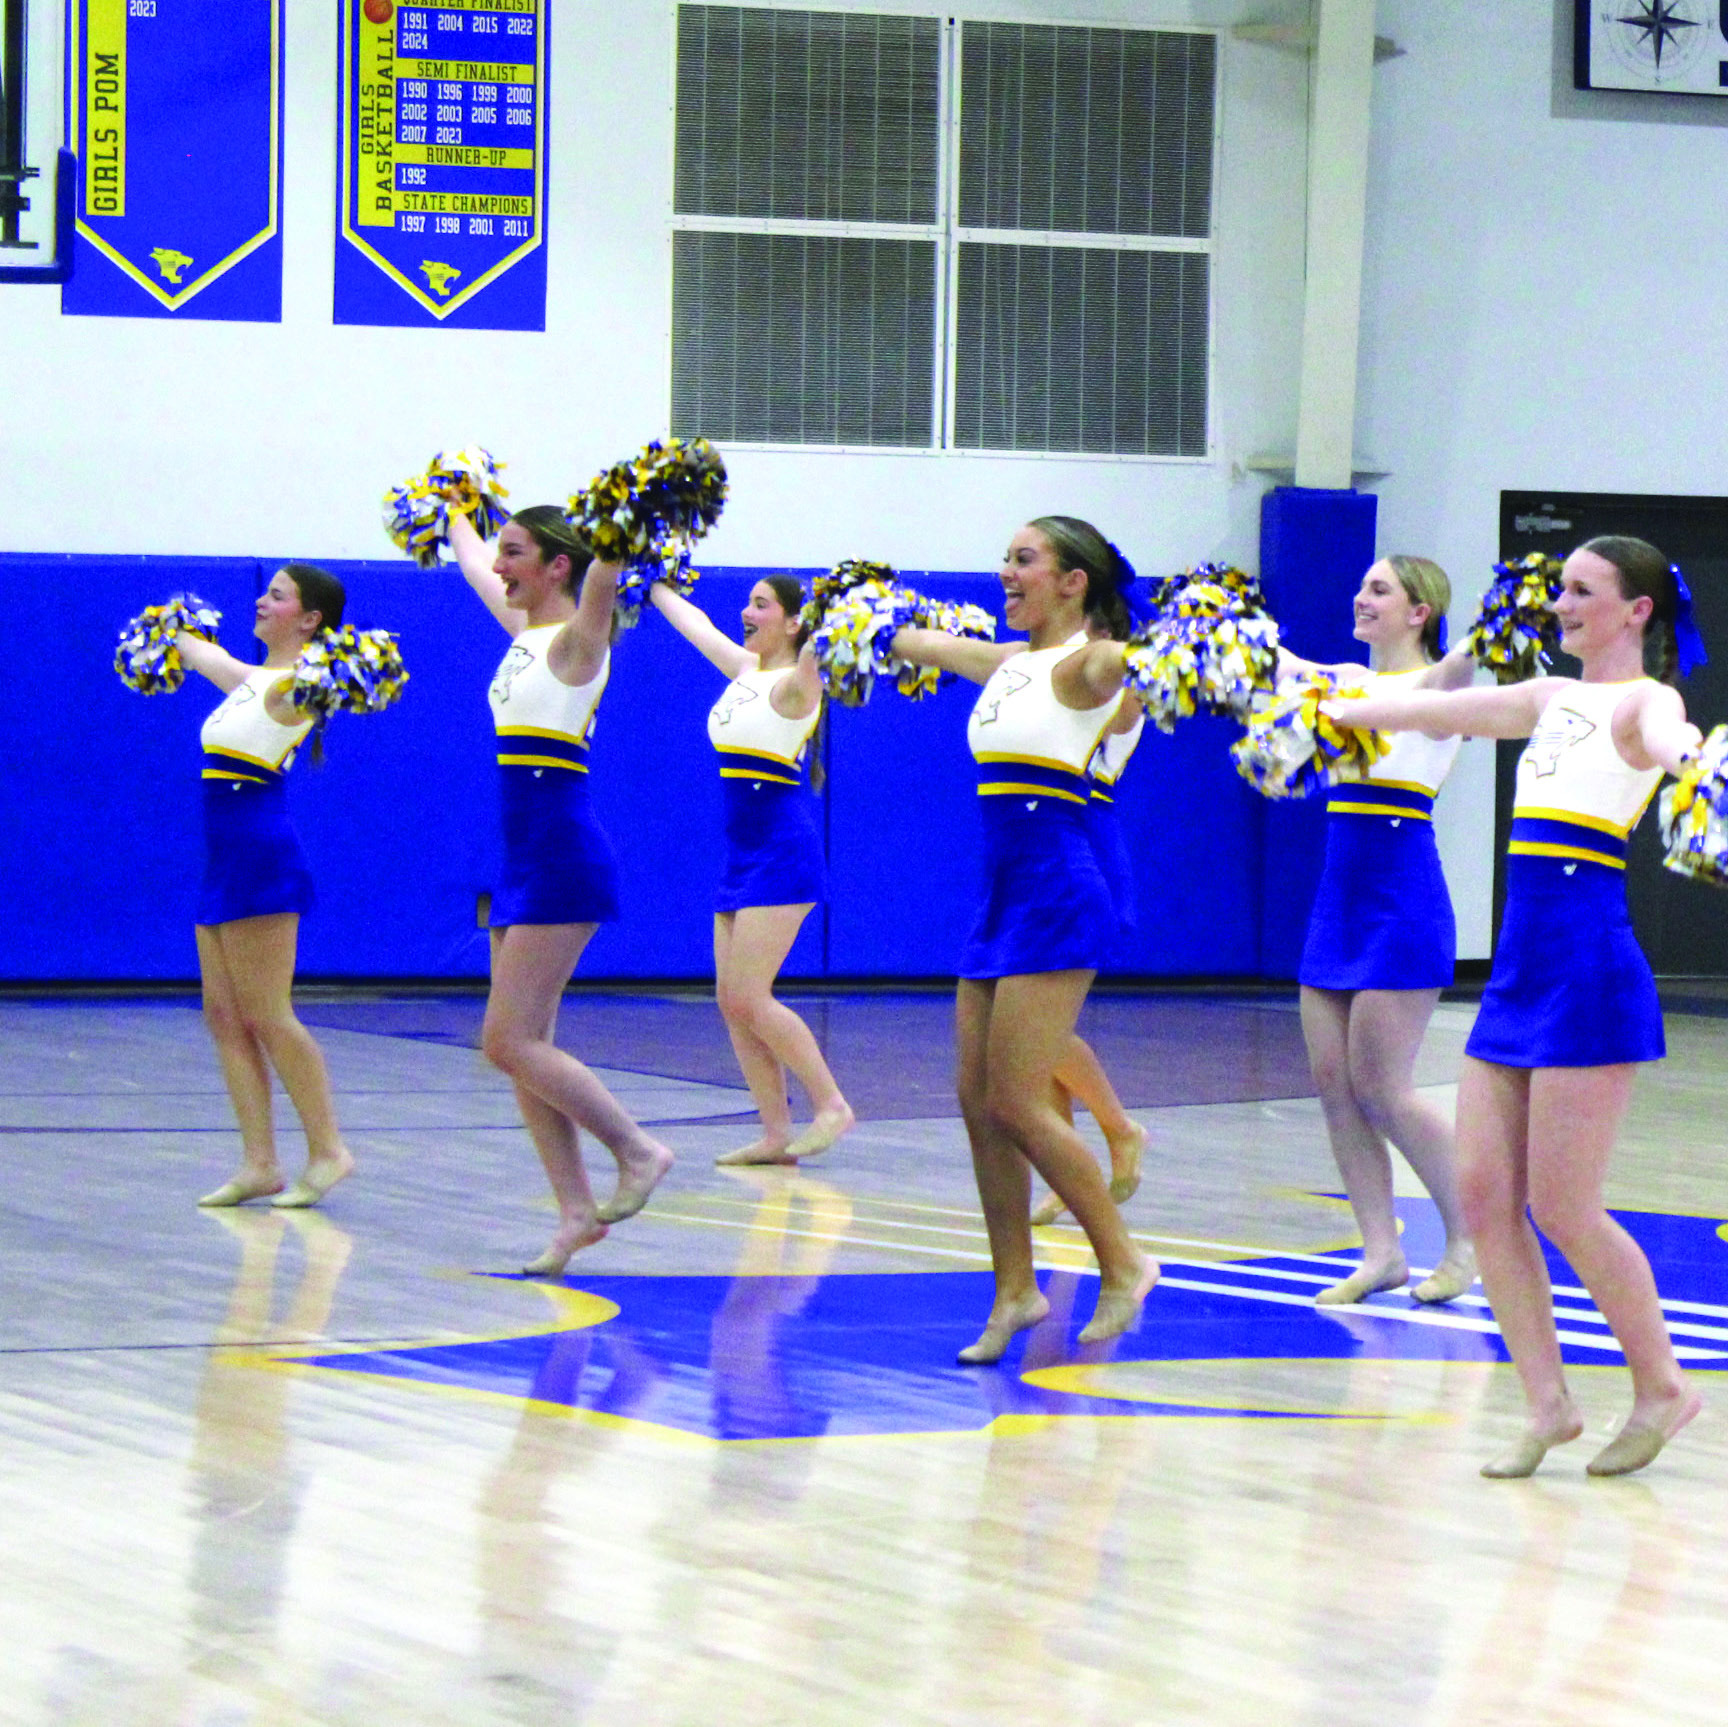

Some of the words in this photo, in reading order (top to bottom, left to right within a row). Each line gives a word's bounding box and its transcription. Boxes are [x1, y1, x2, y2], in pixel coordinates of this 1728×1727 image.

[130, 0, 156, 17] 2023
[403, 13, 428, 29] 1991
[438, 14, 463, 31] 2004
[473, 16, 498, 33] 2015
[507, 18, 533, 35] 2022
[402, 33, 428, 50] 2024
[417, 61, 449, 79] SEMI
[456, 63, 518, 82] FINALIST
[95, 53, 119, 112] POM
[403, 82, 428, 98] 1990
[438, 83, 463, 101] 1996
[472, 85, 498, 102] 1999
[507, 87, 532, 104] 2000
[361, 84, 375, 154] GIRLS
[376, 29, 393, 211] BASKETBALL
[402, 104, 428, 121] 2002
[437, 105, 463, 123] 2003
[472, 107, 497, 124] 2005
[506, 109, 532, 126] 2006
[402, 125, 427, 142] 2007
[436, 127, 462, 144] 2023
[426, 147, 507, 166] RUNNER-UP
[94, 128, 118, 211] GIRLS
[401, 168, 427, 185] 1992
[403, 194, 446, 211] STATE
[452, 196, 528, 214] CHAMPIONS
[401, 216, 426, 233] 1997
[435, 217, 460, 234] 1998
[469, 218, 494, 235] 2001
[504, 220, 528, 237] 2011
